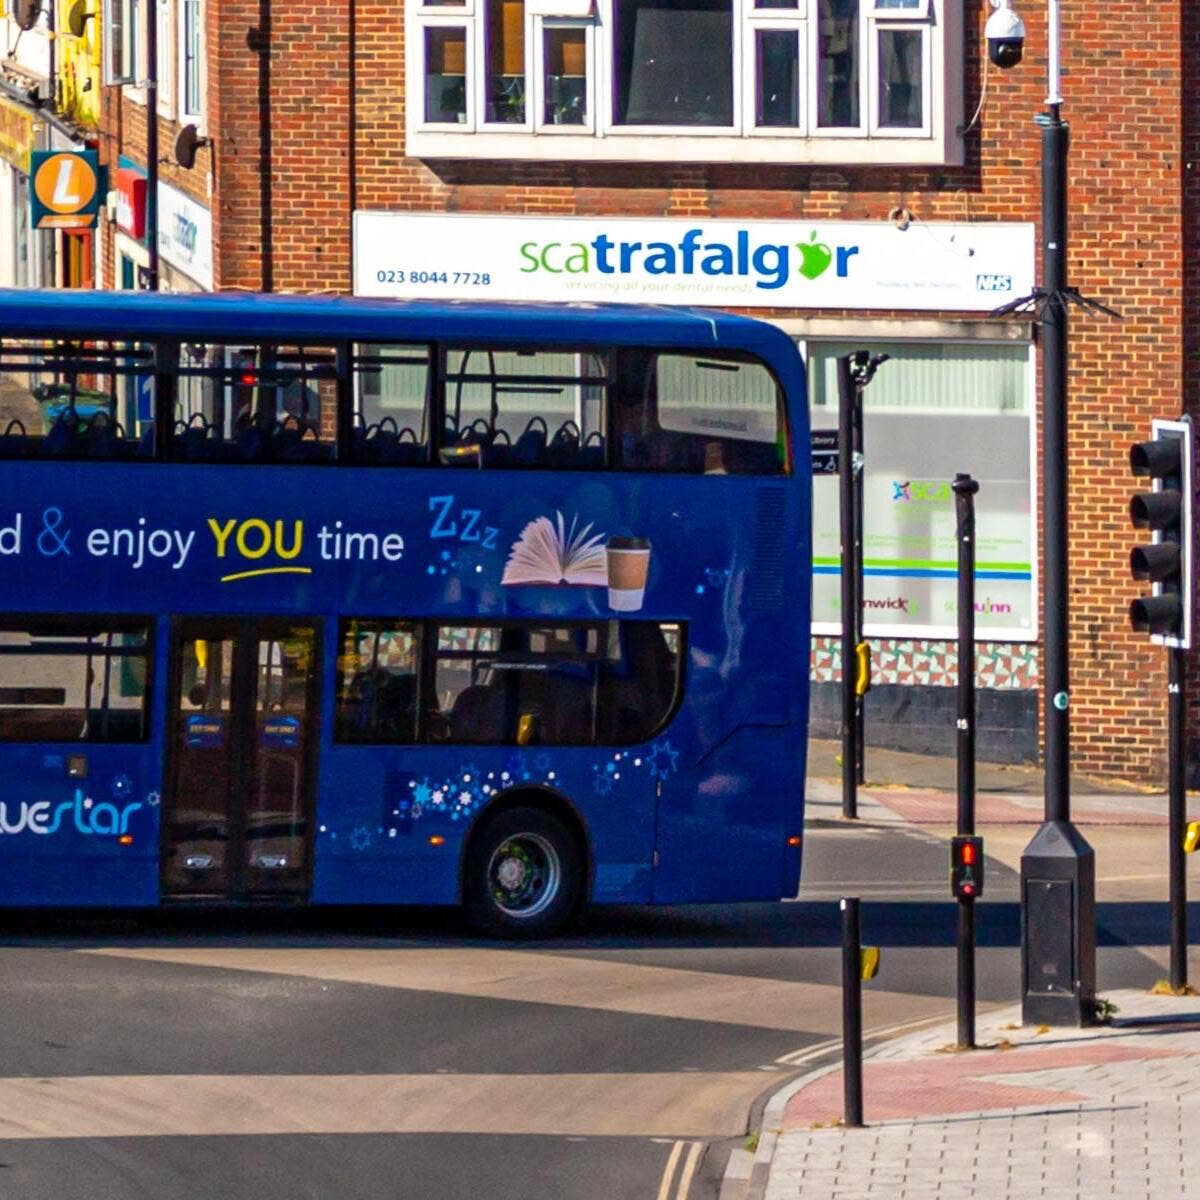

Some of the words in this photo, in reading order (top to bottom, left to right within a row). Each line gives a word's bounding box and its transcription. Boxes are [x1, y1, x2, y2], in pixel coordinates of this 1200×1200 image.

[376, 269, 406, 284] 023
[409, 270, 449, 285] 8044
[451, 271, 492, 286] 7728
[976, 274, 1012, 291] NHS
[36, 506, 71, 557] &
[86, 517, 196, 570] enjoy
[207, 518, 304, 560] YOU
[317, 520, 405, 562] time
